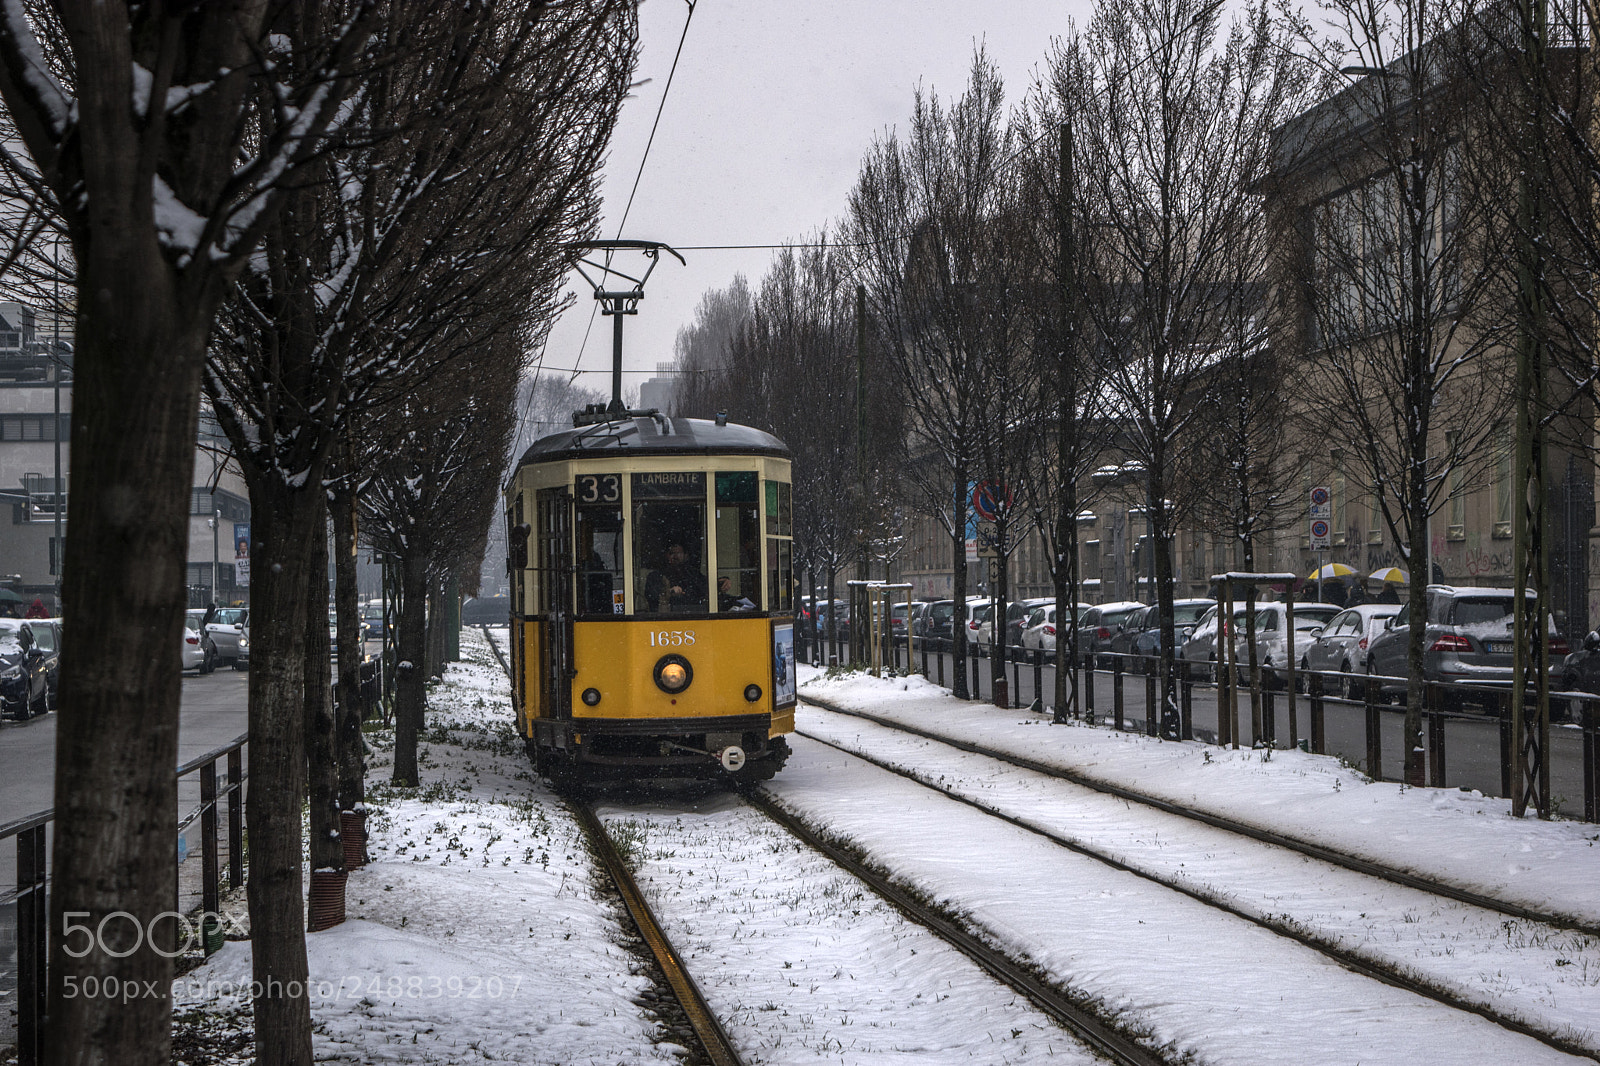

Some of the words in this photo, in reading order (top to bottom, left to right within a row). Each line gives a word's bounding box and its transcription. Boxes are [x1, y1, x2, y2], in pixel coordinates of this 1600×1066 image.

[641, 473, 699, 484] LAMBRATE
[581, 475, 619, 502] 33
[650, 629, 696, 647] 1658
